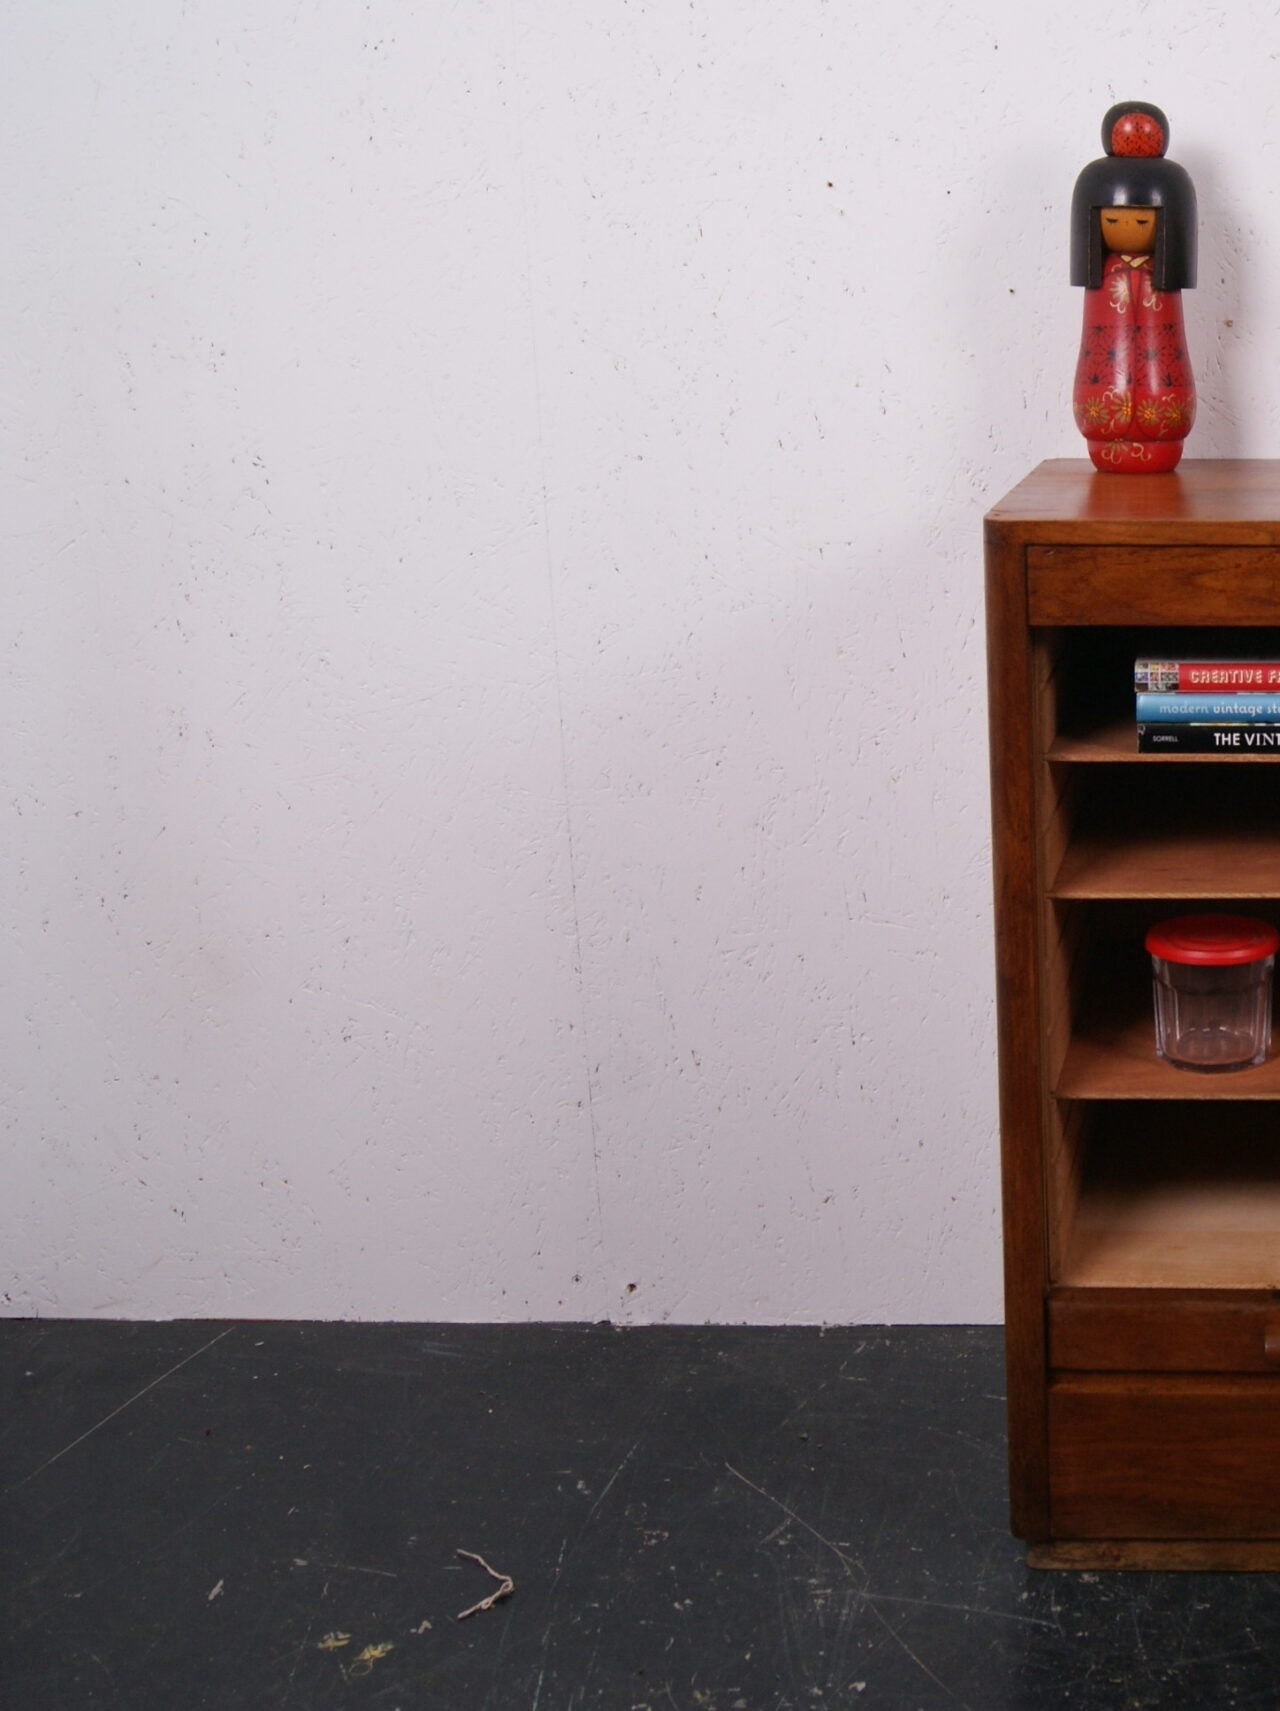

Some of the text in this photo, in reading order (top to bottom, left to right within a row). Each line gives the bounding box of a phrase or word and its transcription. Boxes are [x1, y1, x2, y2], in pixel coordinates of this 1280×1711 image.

[1189, 669, 1262, 684] CREATIVE
[1159, 701, 1209, 714] modern
[1213, 701, 1263, 717] vintage
[1213, 732, 1240, 746] THE
